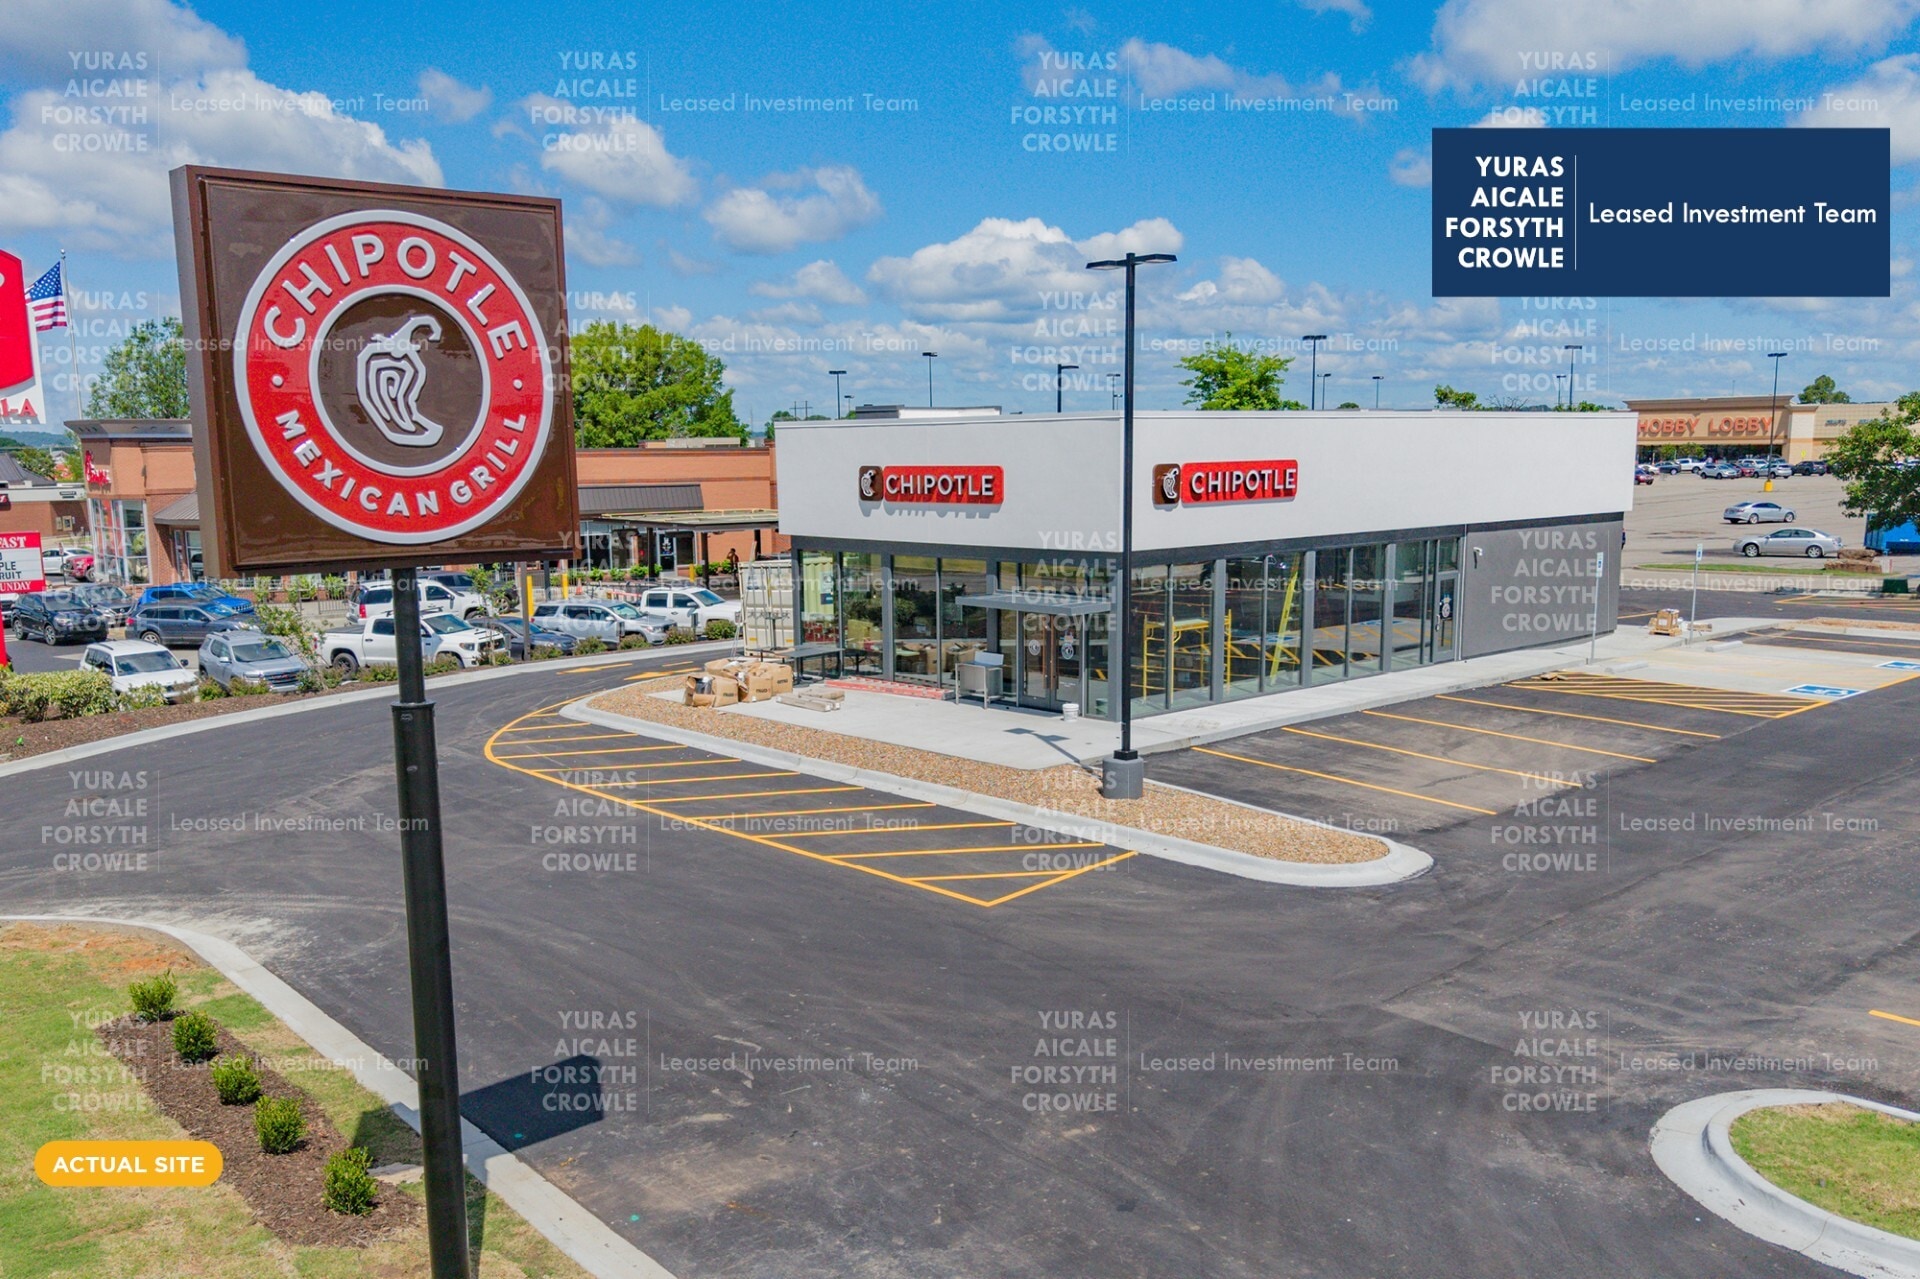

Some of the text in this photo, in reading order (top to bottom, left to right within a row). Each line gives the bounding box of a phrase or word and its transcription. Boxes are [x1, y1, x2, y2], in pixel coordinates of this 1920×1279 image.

[263, 233, 528, 360] CHIPOTLE
[1638, 416, 1773, 434] HOBBY LOBBY
[275, 410, 527, 517] MEXICAN GRILL
[885, 474, 994, 496] CHIPOTLE
[1191, 468, 1297, 494] CHIPOTLE
